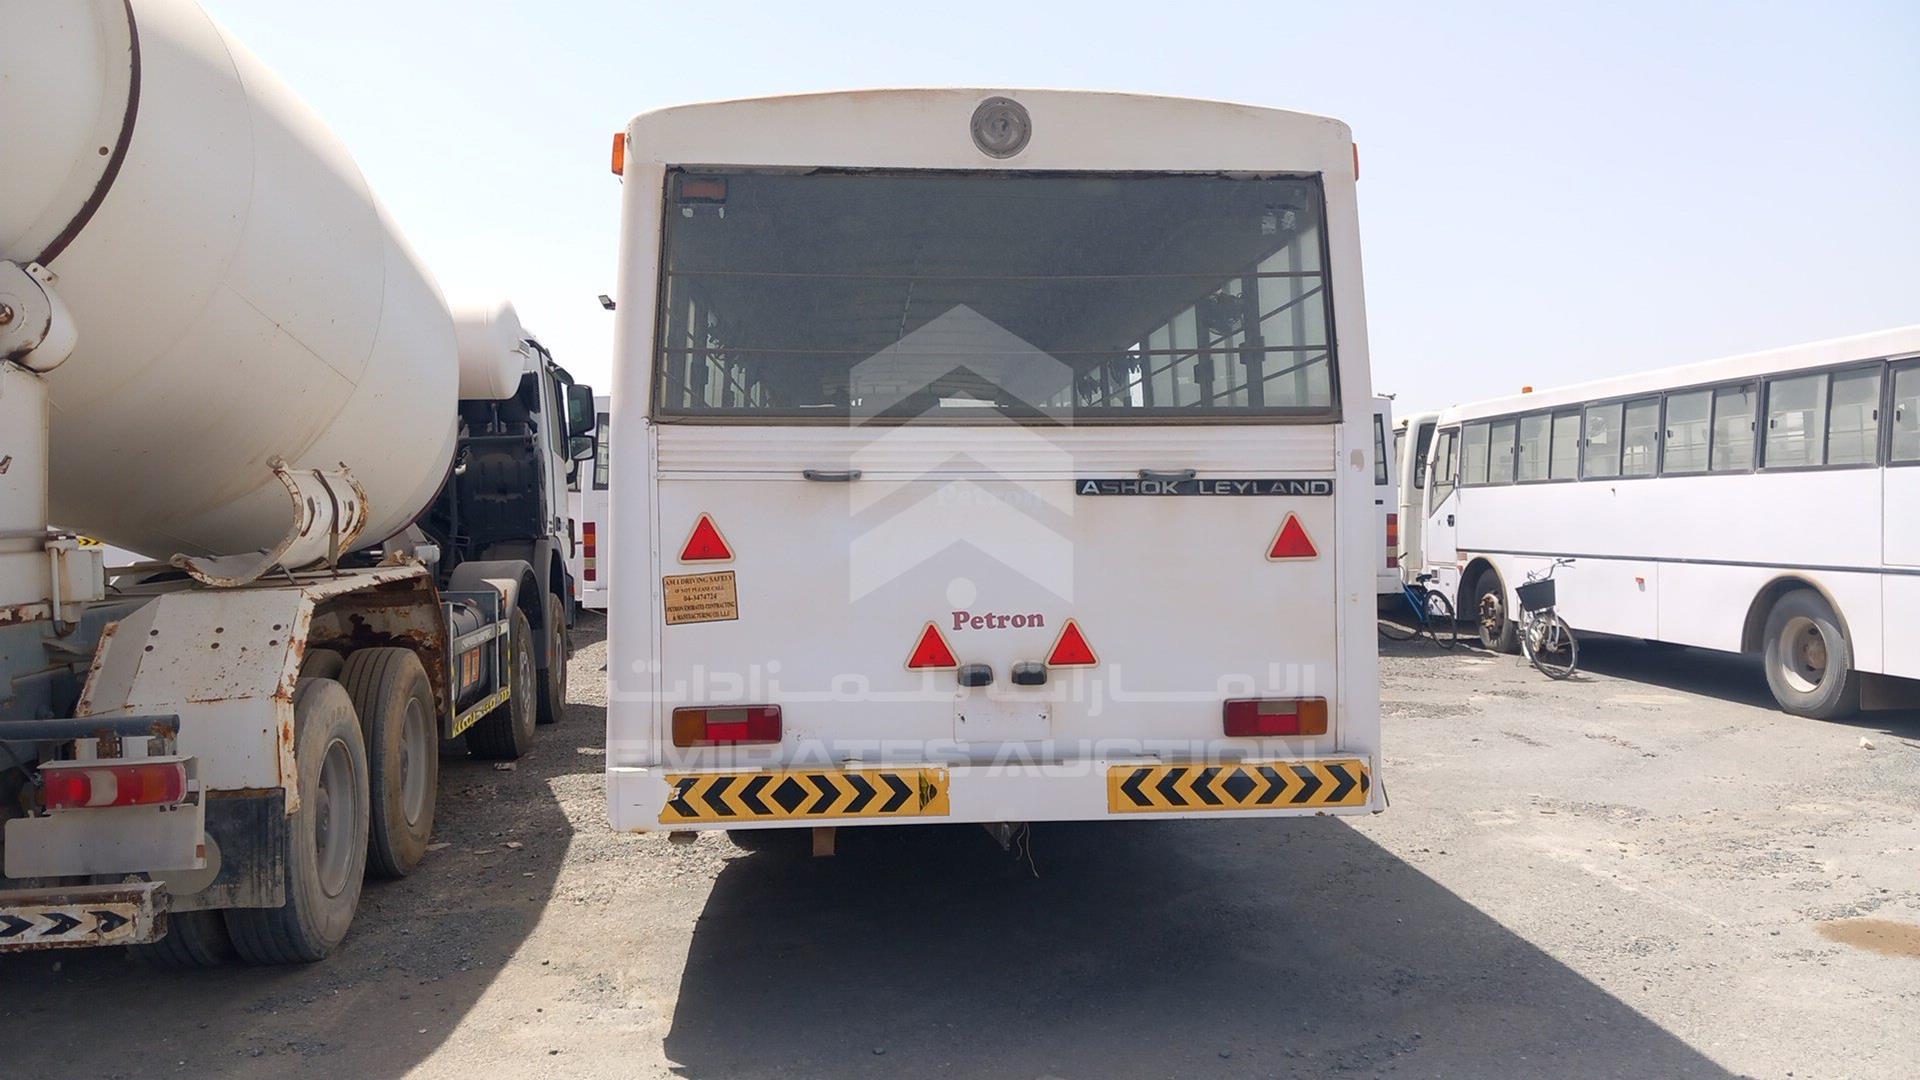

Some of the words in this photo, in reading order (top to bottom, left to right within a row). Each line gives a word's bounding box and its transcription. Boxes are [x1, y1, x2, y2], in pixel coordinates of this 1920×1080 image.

[1081, 480, 1179, 494] ASHOK
[1200, 480, 1330, 494] LEYLAND
[680, 576, 709, 585] DRIVING
[952, 611, 1044, 630] Petron
